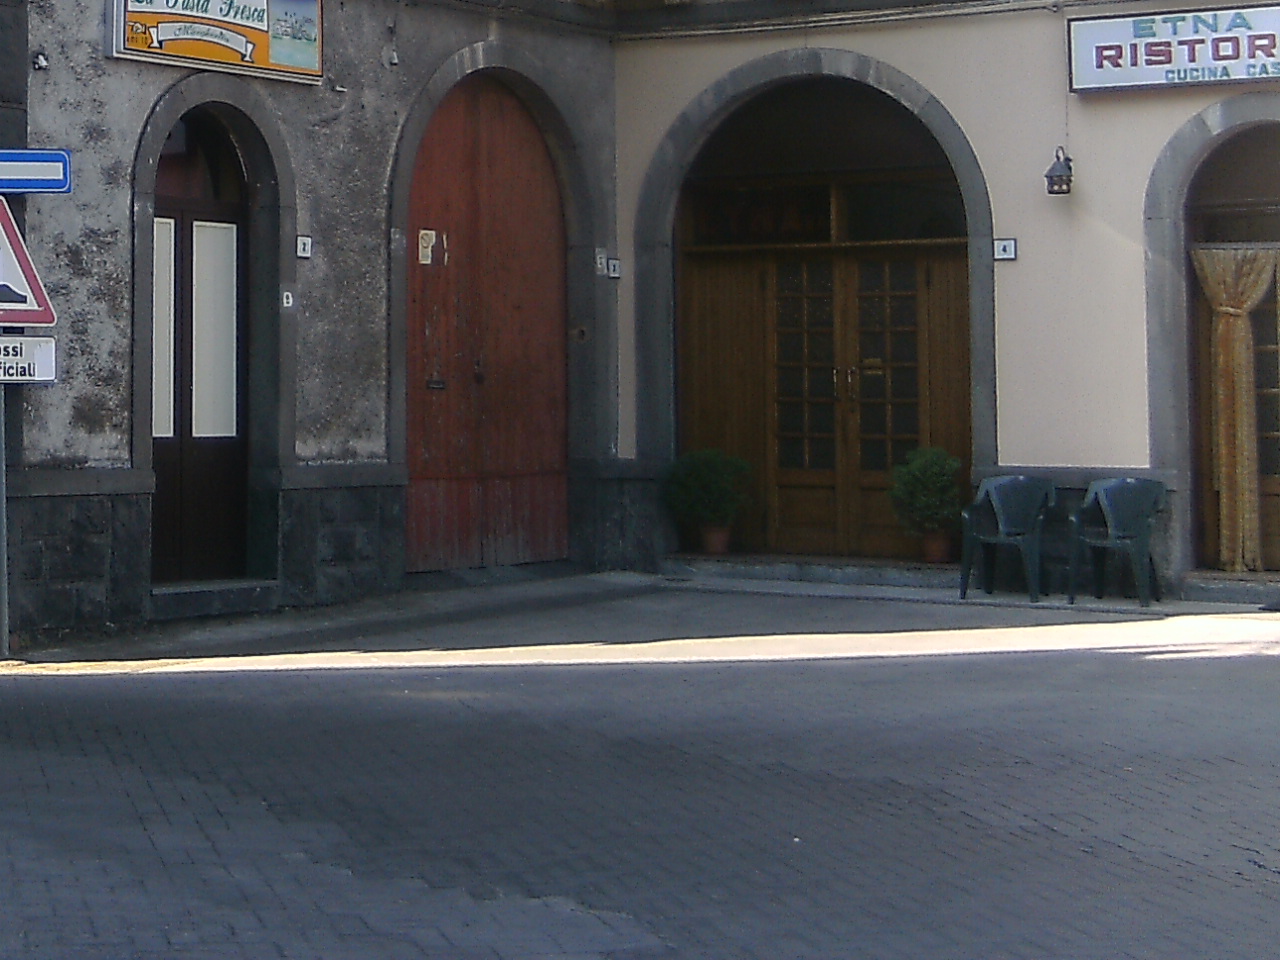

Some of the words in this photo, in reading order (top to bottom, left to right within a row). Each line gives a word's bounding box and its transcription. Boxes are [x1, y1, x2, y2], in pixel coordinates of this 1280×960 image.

[1131, 11, 1253, 39] ETNA
[1094, 33, 1277, 70] RISTOR
[1164, 65, 1231, 82] CUCINA
